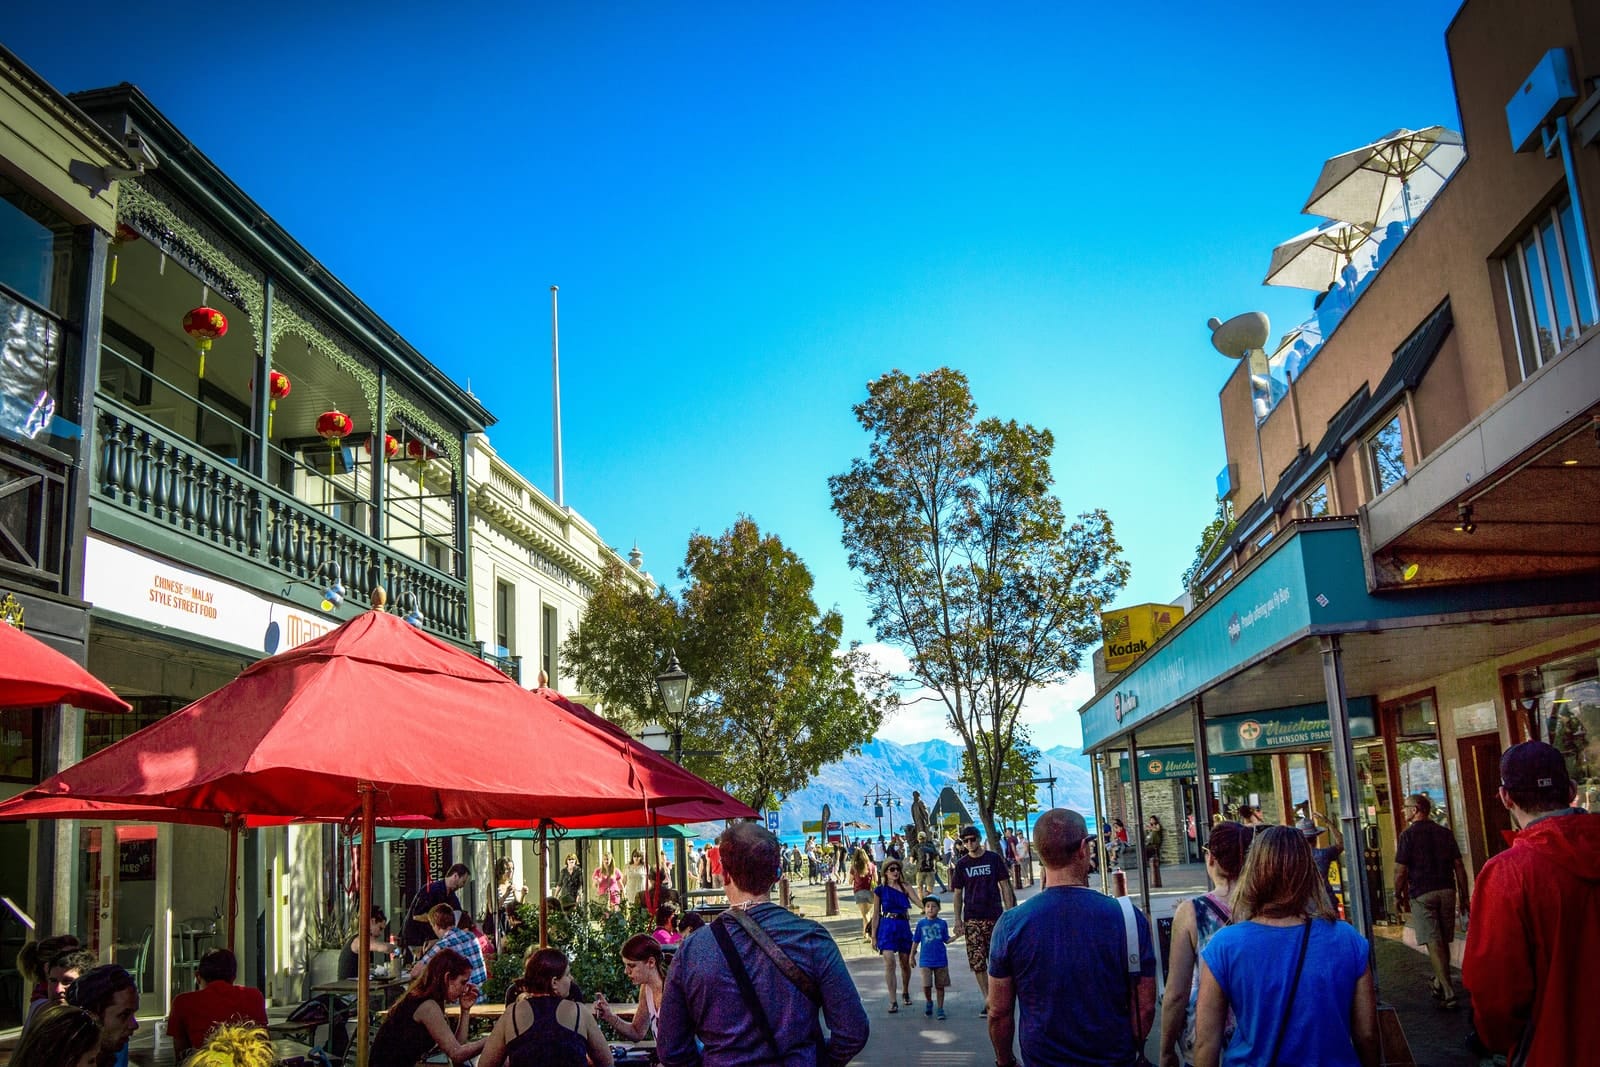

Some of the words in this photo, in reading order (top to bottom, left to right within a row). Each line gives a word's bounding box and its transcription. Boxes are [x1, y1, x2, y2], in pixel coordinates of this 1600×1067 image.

[154, 575, 184, 595] CHINESE
[191, 587, 214, 603] MALAY
[149, 589, 172, 607] STYLE
[173, 596, 199, 614] STREET
[200, 604, 217, 619] FOOD
[1108, 640, 1148, 657] Kodak
[1266, 733, 1309, 745] WILKINSONS
[1310, 731, 1332, 740] PHAR
[965, 864, 992, 878] VANS
